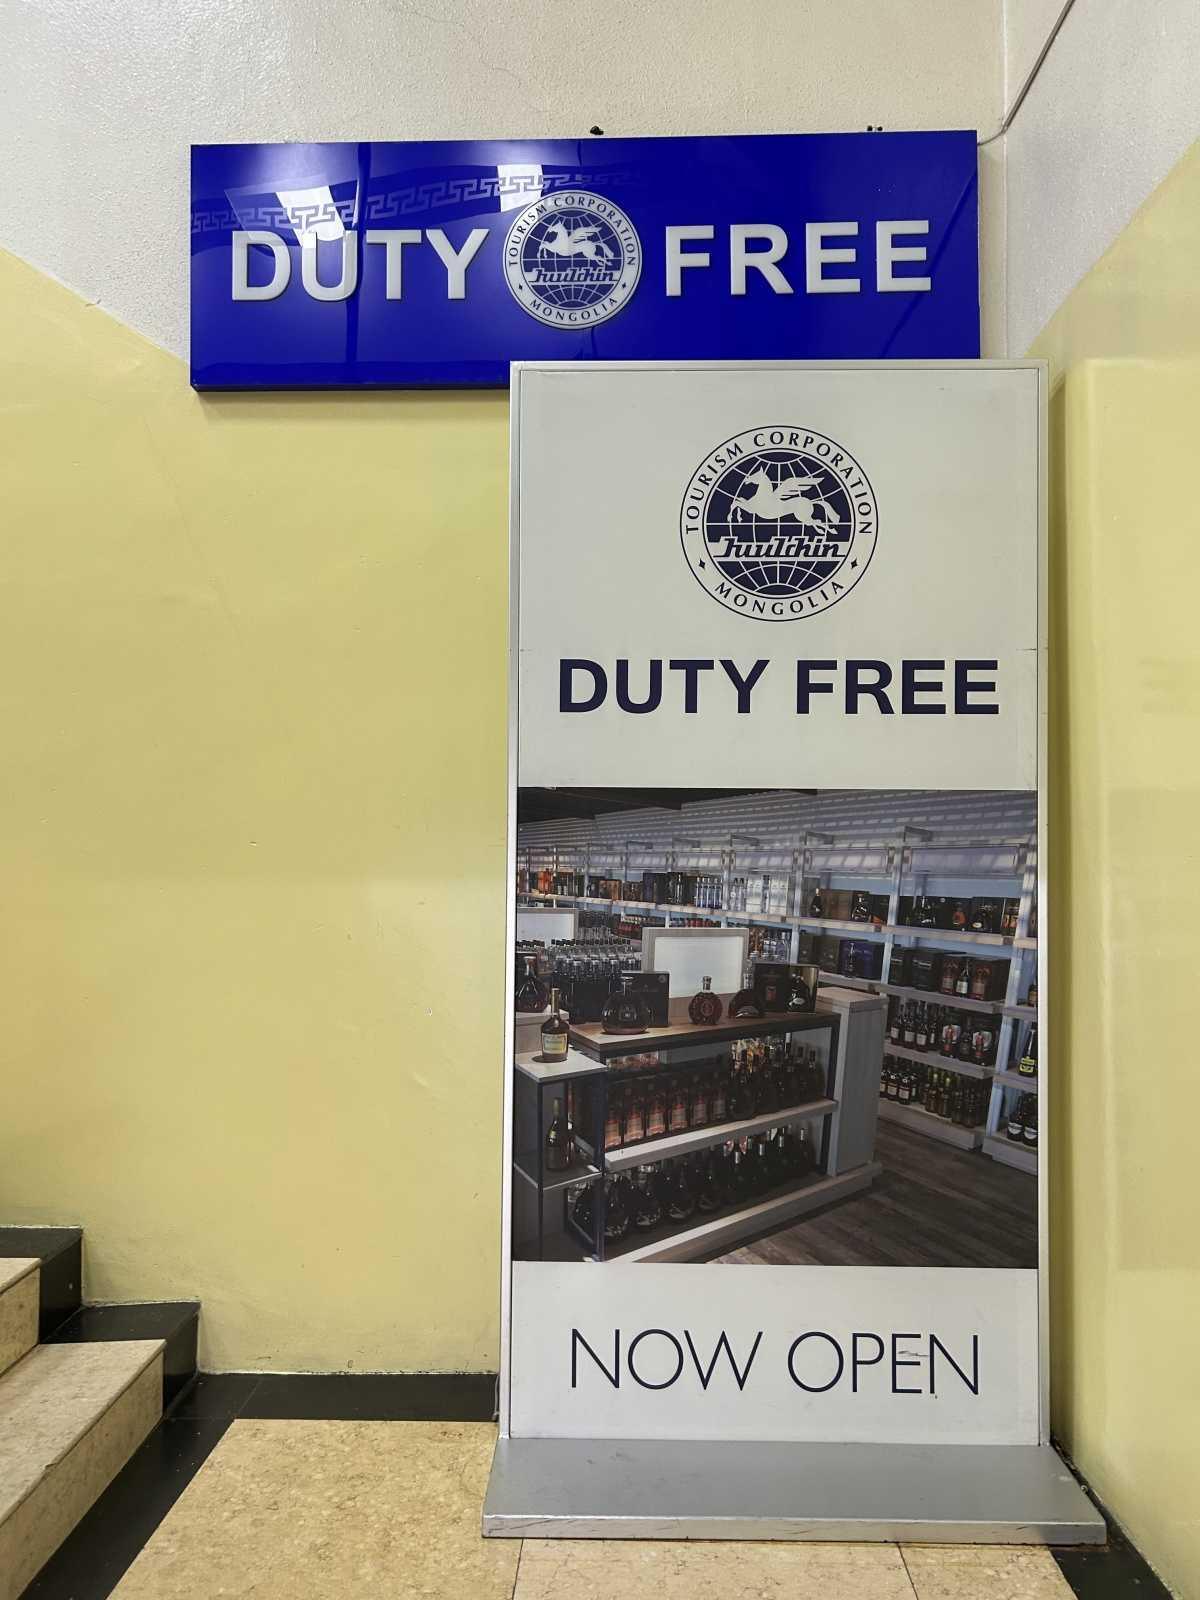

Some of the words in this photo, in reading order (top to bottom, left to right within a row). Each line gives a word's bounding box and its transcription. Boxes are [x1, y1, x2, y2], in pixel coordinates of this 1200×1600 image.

[231, 228, 490, 301] DUTY
[665, 219, 932, 297] FREE
[509, 204, 547, 266] TOURISM
[554, 196, 636, 266] CORPORATION
[530, 299, 618, 321] MONGOLIA
[686, 443, 743, 534] TOURISM
[753, 431, 873, 534] CORPORATION
[715, 581, 844, 615] MONGOLIA
[560, 659, 769, 714] DUTY
[797, 660, 998, 714] FREE
[572, 1328, 763, 1391] NOW
[788, 1331, 979, 1395] OPEN
